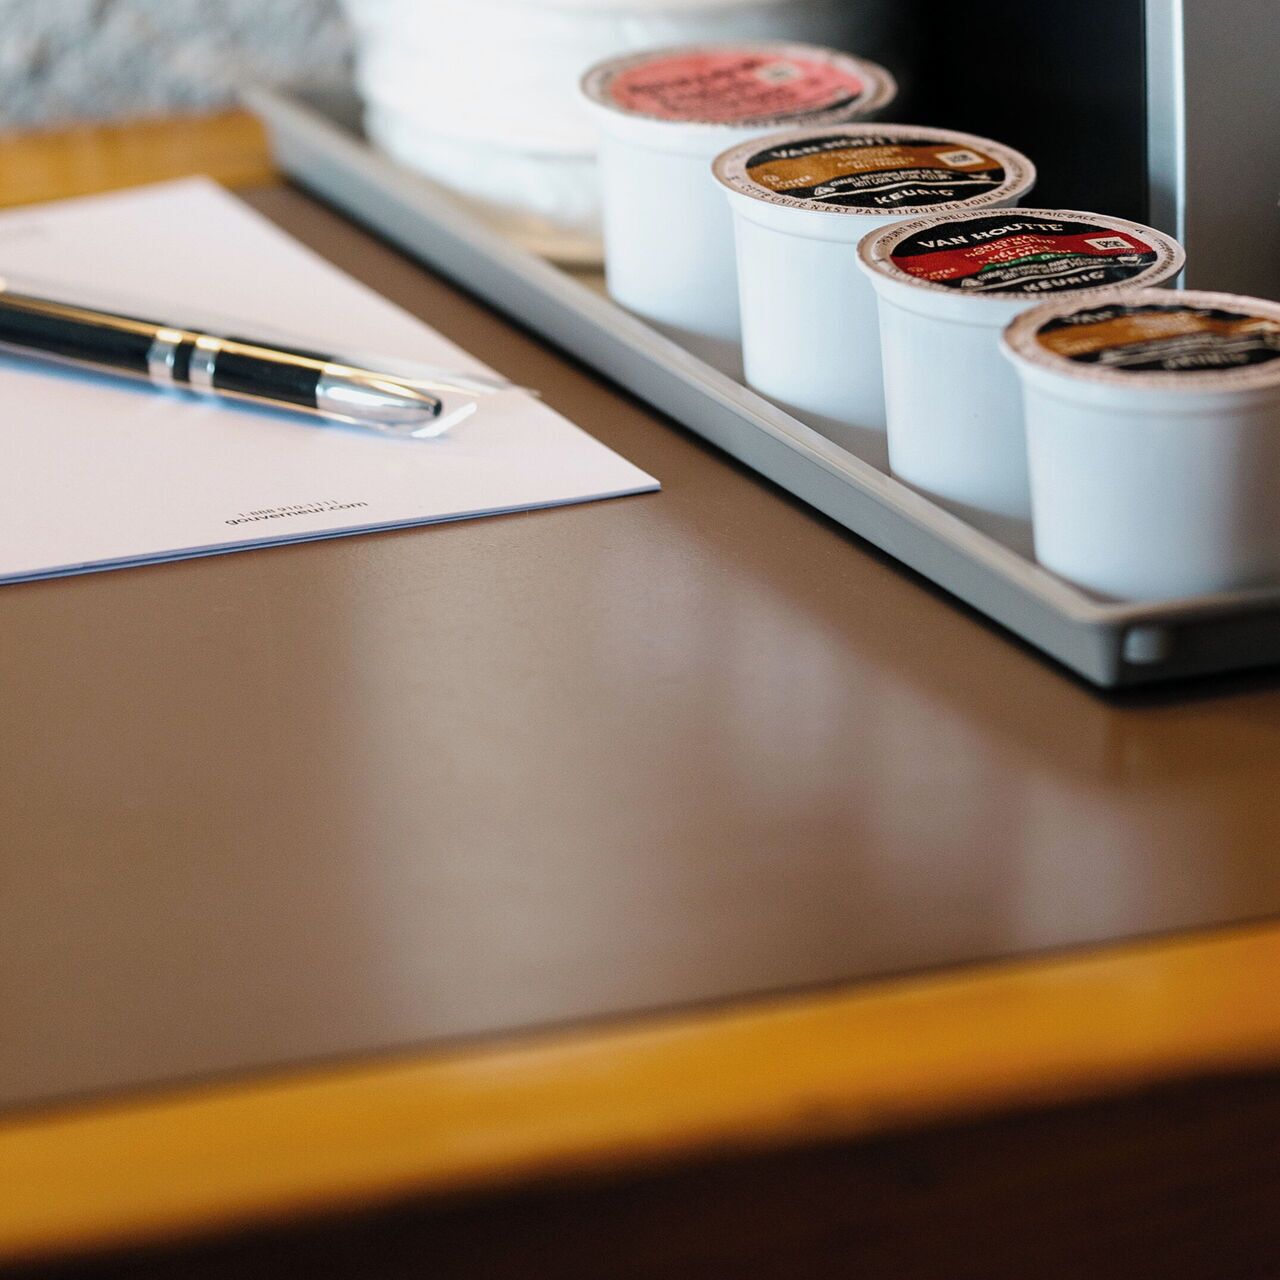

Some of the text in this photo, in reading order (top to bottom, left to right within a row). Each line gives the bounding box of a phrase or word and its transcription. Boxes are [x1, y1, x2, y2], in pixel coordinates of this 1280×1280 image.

[873, 189, 955, 205] KEURIG
[916, 222, 1064, 249] VAN HOUTTE
[1022, 270, 1105, 292] KEURIG
[225, 501, 369, 526] gouverneur.com
